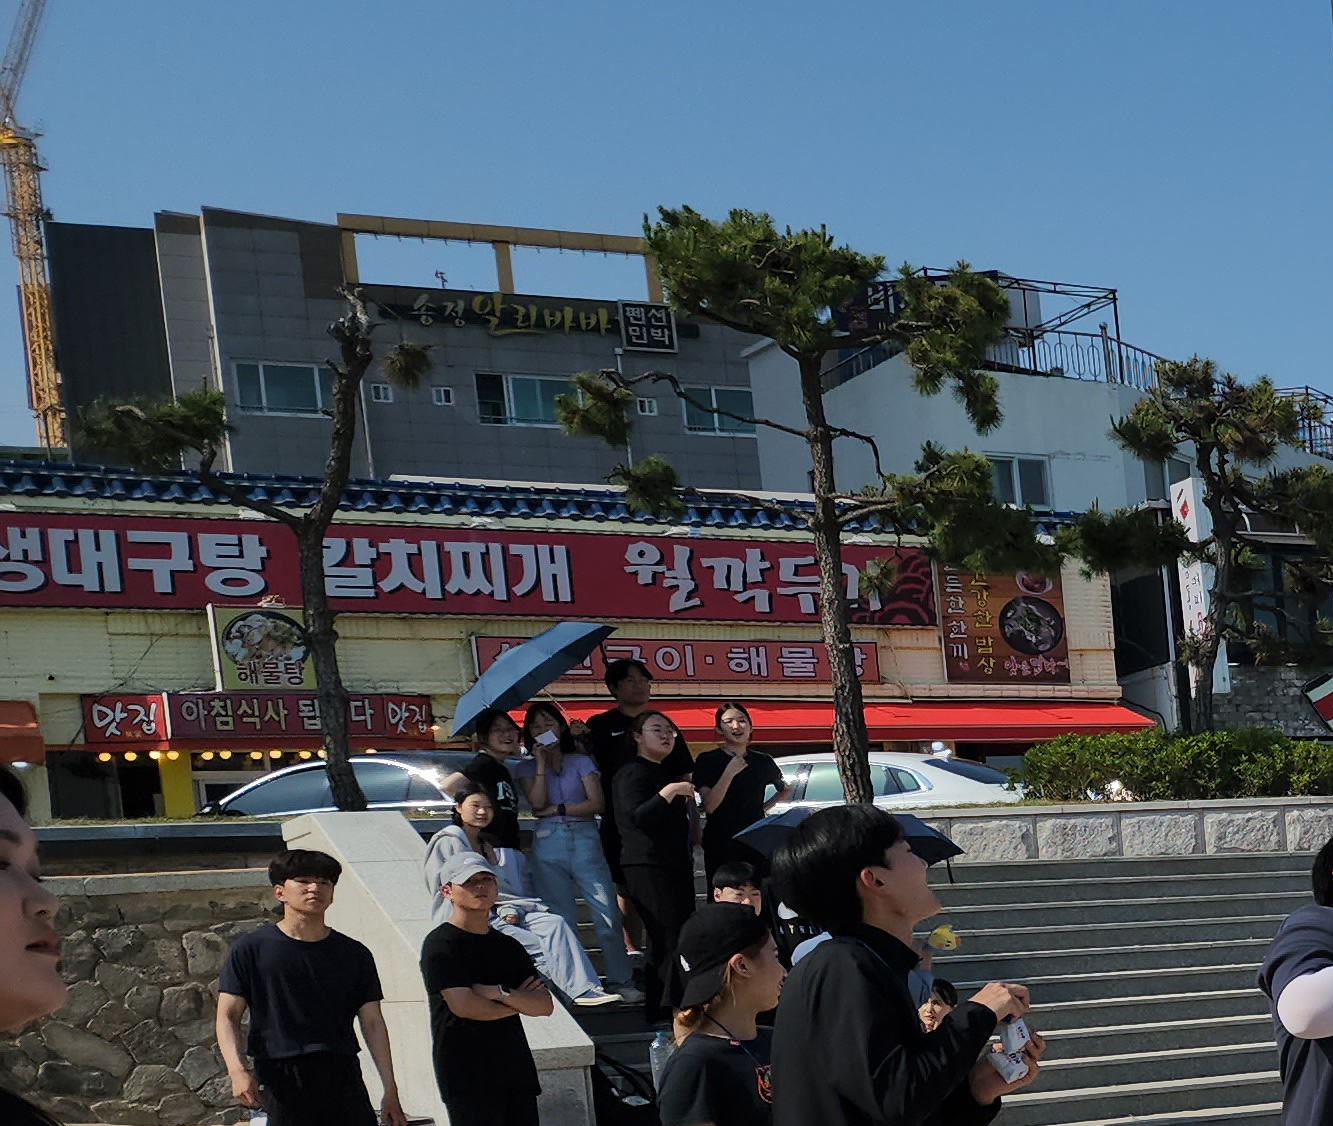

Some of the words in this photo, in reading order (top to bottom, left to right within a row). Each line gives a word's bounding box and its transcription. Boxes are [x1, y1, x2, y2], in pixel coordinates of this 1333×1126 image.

[408, 293, 466, 328] 송정
[471, 291, 612, 338] 알리바바
[624, 305, 667, 326] 펜션
[628, 326, 670, 346] 민박
[0, 526, 269, 598] 생대구탕
[321, 536, 574, 603] 갈치찌개
[236, 661, 305, 686] 해물탕
[181, 698, 289, 732] 아침식사
[297, 698, 376, 732] 됩다
